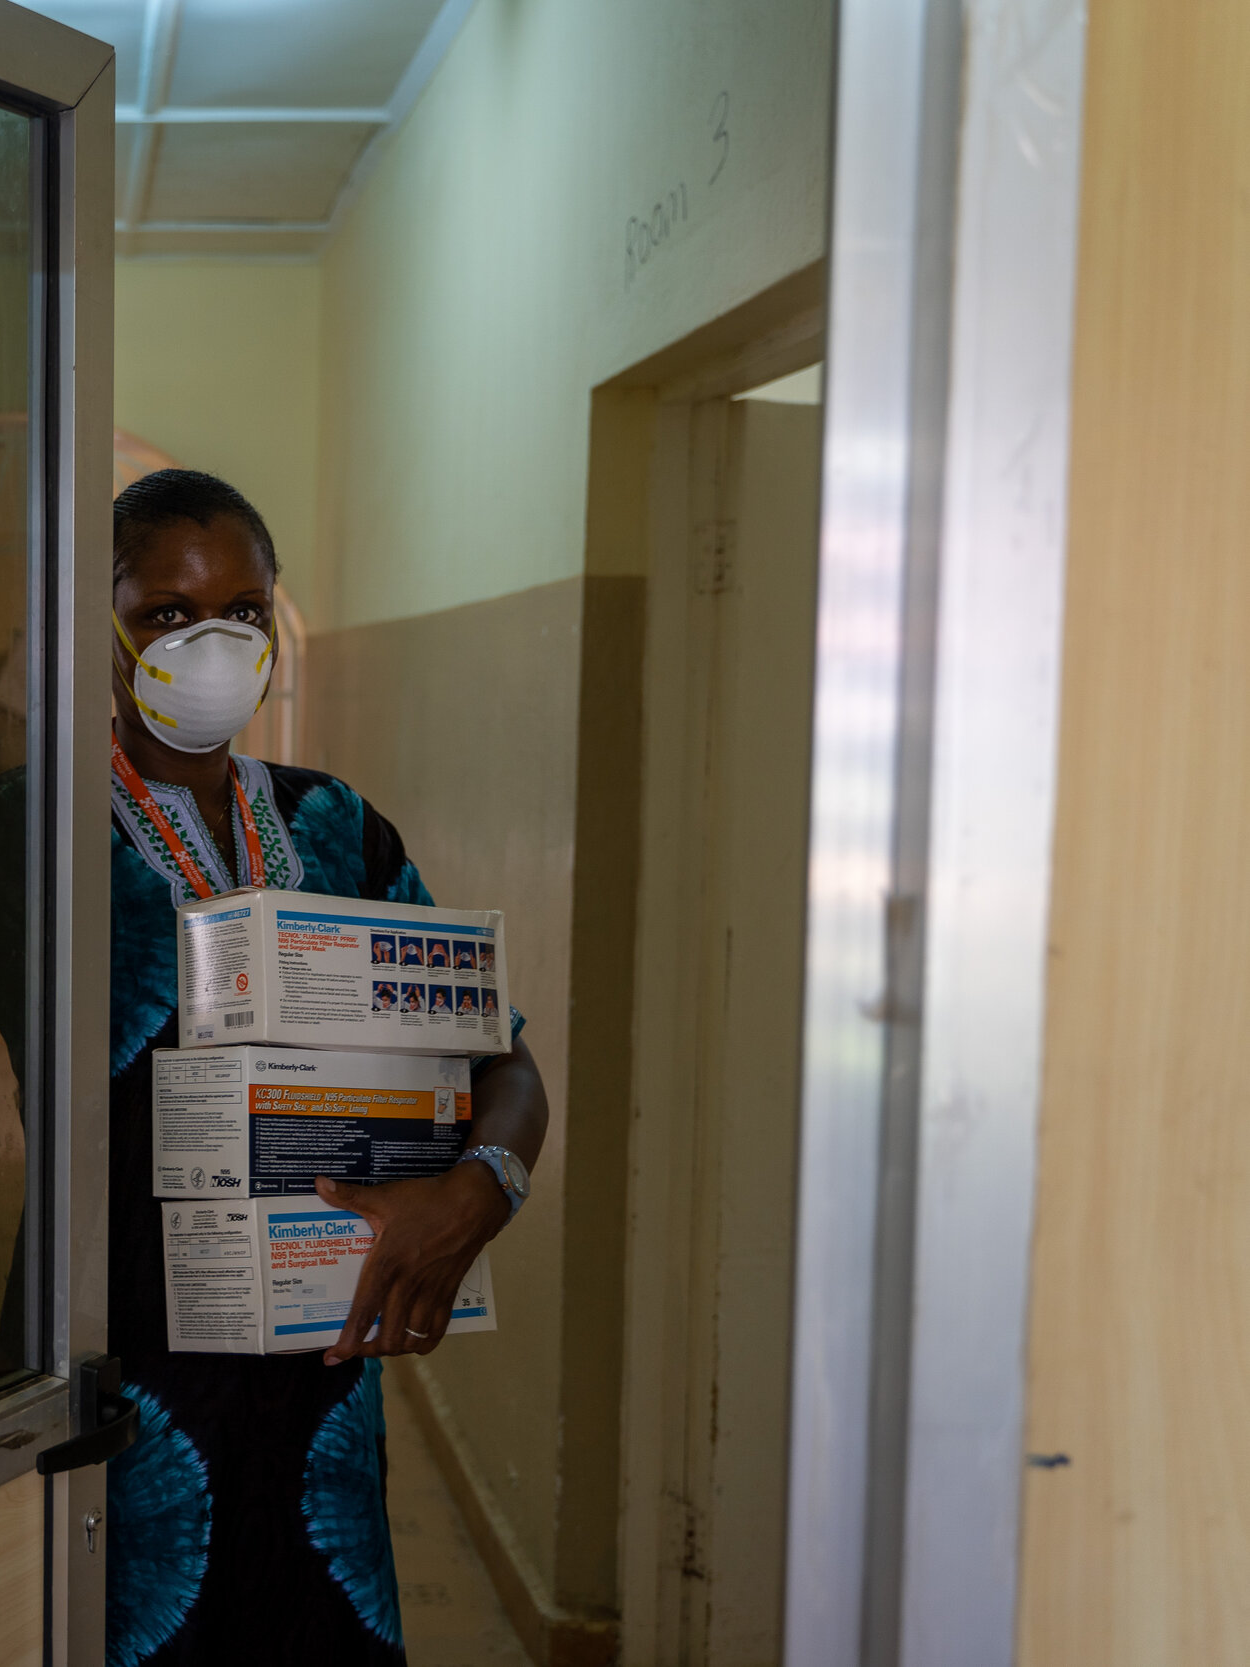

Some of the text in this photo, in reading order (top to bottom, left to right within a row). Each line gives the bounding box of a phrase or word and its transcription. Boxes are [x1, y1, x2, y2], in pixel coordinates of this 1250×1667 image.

[707, 90, 730, 186] 3
[277, 920, 341, 934] Kimberly-Clark
[289, 944, 311, 952] Surgical
[290, 938, 318, 947] Particulate
[334, 941, 359, 950] Respirator
[268, 1061, 318, 1073] Kimberly-Clark
[255, 1088, 282, 1101] KC300
[324, 1092, 338, 1102] N95
[339, 1092, 372, 1104] Particulate
[372, 1095, 388, 1104] Filter
[389, 1096, 418, 1107] Respirator
[255, 1101, 272, 1111] with
[311, 1104, 323, 1112] and
[349, 1105, 368, 1115] Lining
[209, 1175, 242, 1188] NIOSH
[268, 1221, 356, 1239] Kimberly-Clark
[270, 1241, 303, 1251] TECNOL
[305, 1238, 352, 1249] FLUIDSHIELD
[271, 1251, 287, 1260] N95
[289, 1248, 328, 1259] Particulate
[329, 1247, 347, 1256] Filter
[271, 1257, 339, 1270] and Surgical Mask
[272, 1279, 291, 1287] Regular
